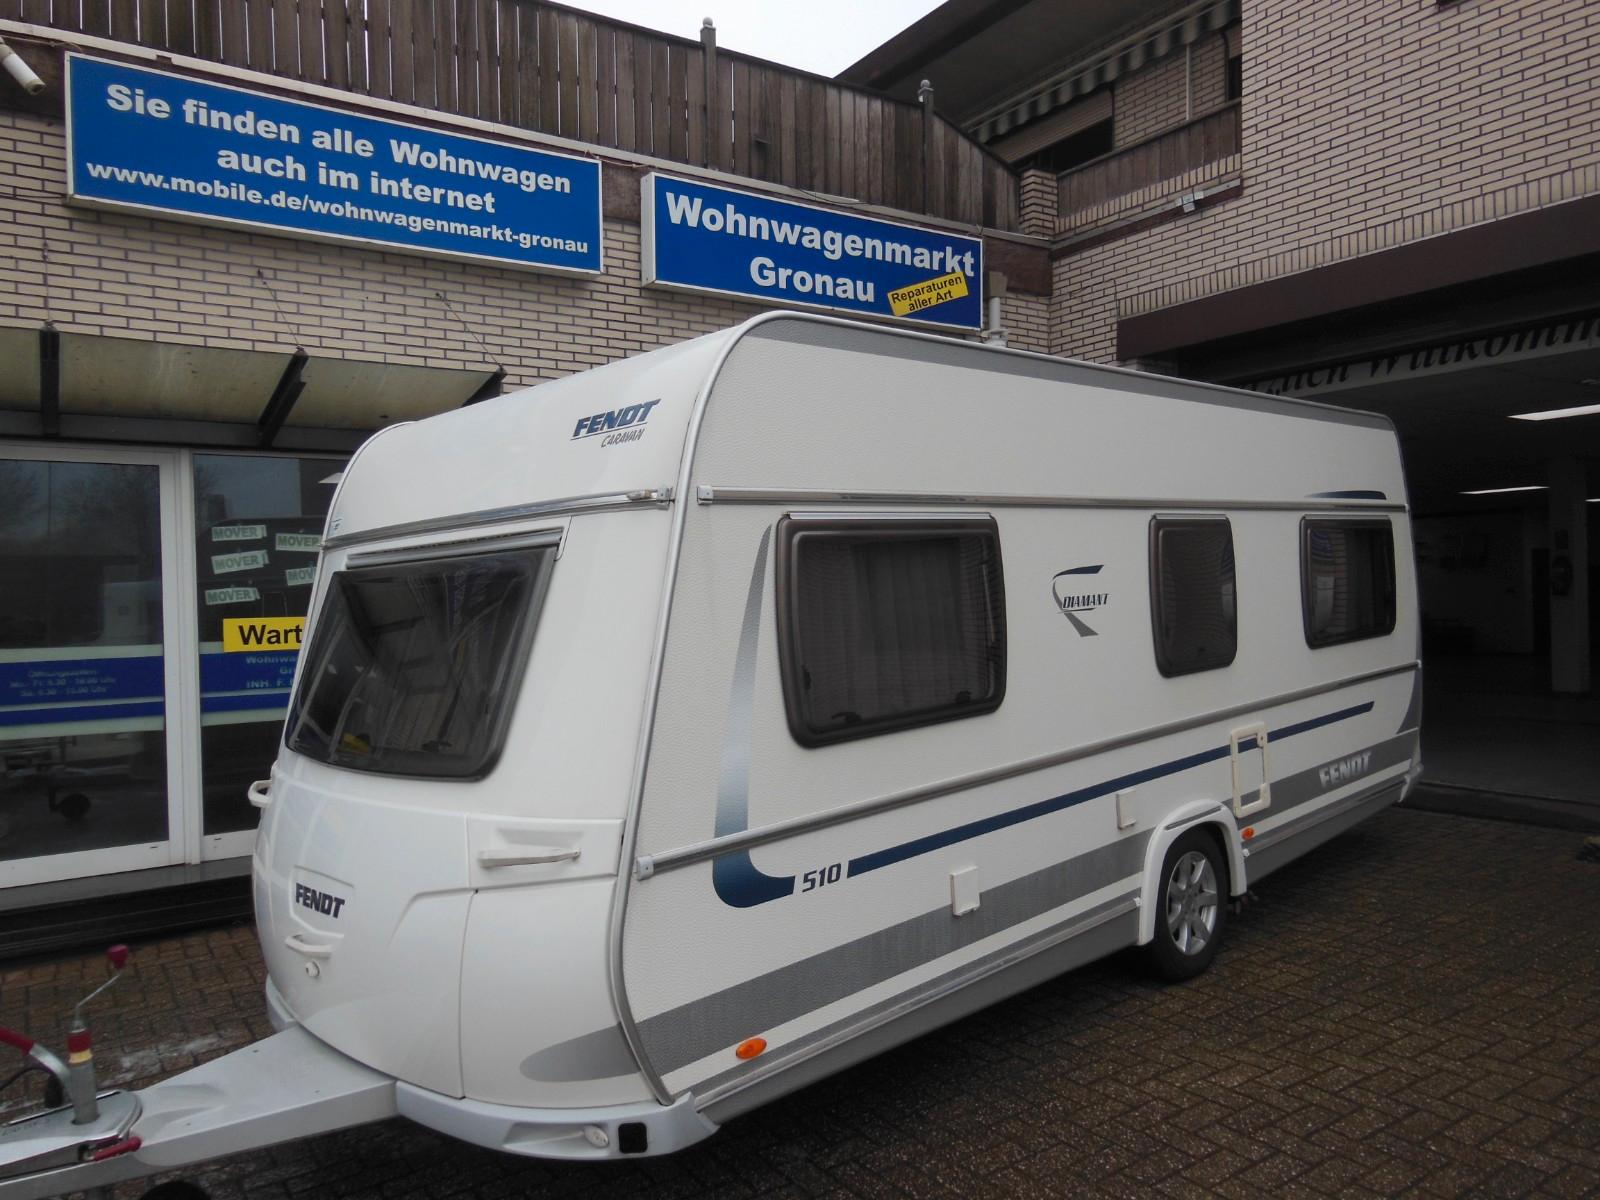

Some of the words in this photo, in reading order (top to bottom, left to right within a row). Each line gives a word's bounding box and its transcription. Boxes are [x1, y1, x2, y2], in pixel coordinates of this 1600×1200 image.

[107, 84, 170, 118] Sie
[183, 99, 300, 144] finden
[312, 129, 374, 158] alle
[390, 139, 571, 193] Wohnwagen
[217, 150, 306, 181] auch
[318, 161, 359, 190] im
[370, 171, 496, 214] internet
[87, 162, 588, 253] www.mobile.de/wohnwagenmarkt-gronau
[666, 192, 974, 277] Wohnwagenmarkt
[750, 257, 875, 302] Gronau
[891, 276, 962, 304] Reparaturen
[908, 297, 932, 311] aller
[936, 289, 953, 303] Art
[1368, 320, 1600, 377] Willkomm
[573, 398, 661, 437] FENDT
[601, 428, 645, 448] CARAVAN
[214, 526, 257, 539] MOVER
[214, 554, 259, 571] MOVER
[287, 570, 314, 581] MOV
[207, 589, 252, 603] MOVER
[1062, 593, 1111, 609] DIAMANT
[238, 625, 302, 645] Wart
[245, 655, 297, 664] Wohnwa
[1319, 751, 1372, 788] FENDT
[802, 862, 842, 893] 510
[295, 882, 346, 919] FENDT
